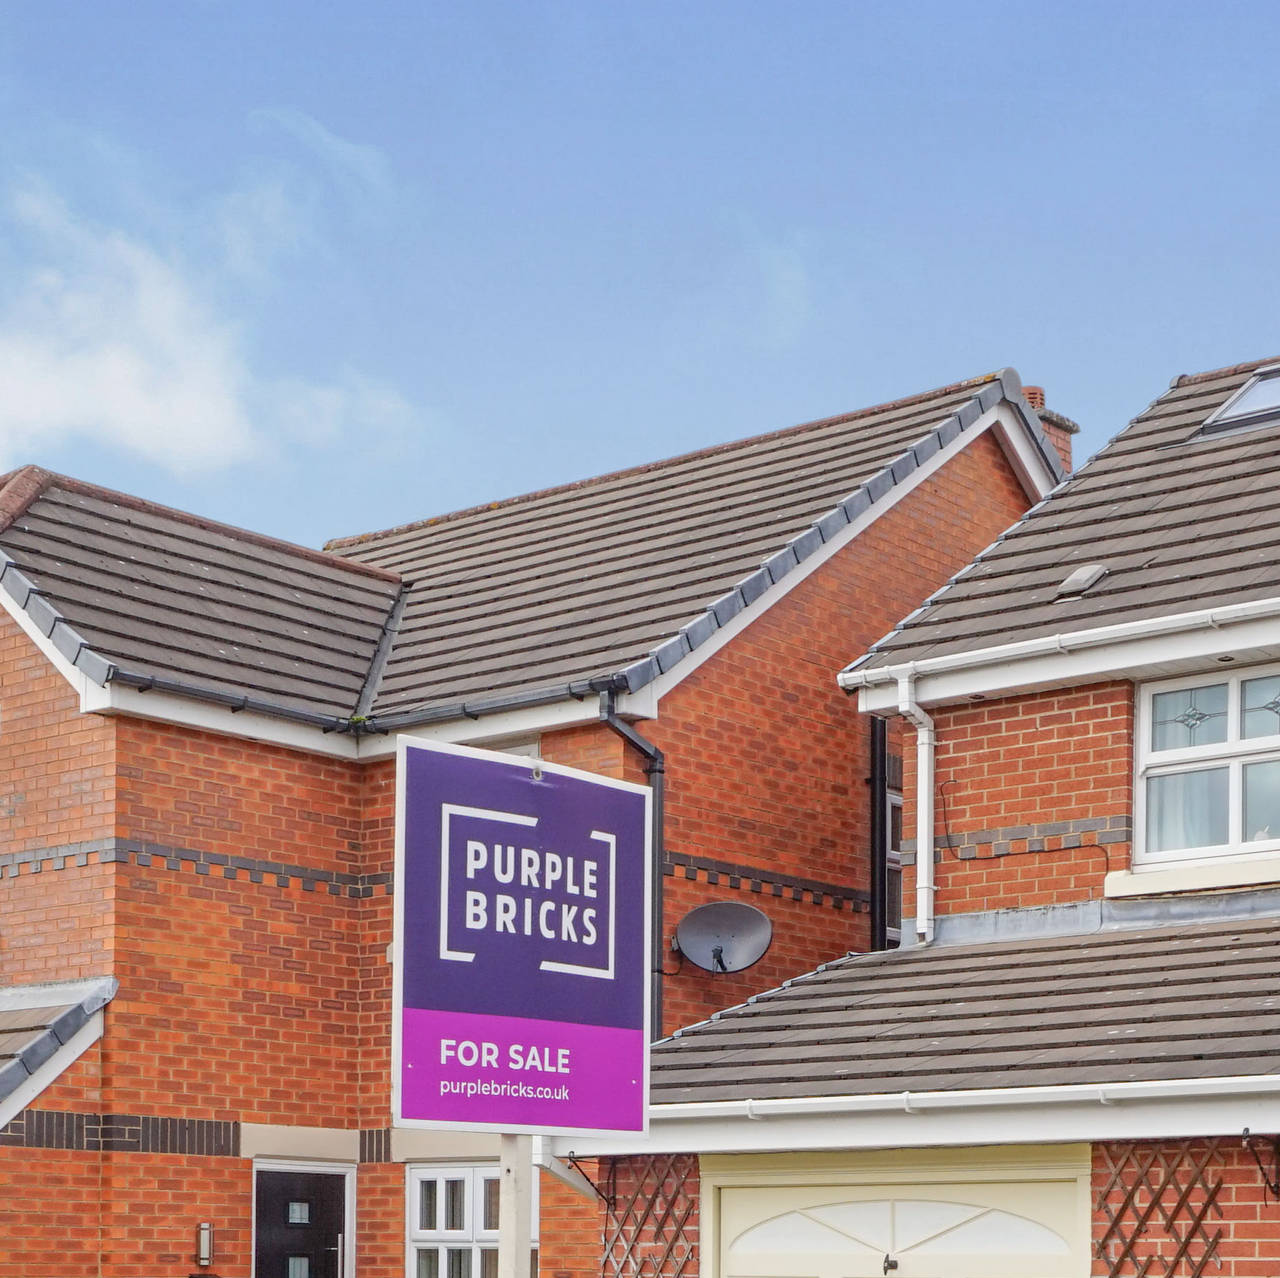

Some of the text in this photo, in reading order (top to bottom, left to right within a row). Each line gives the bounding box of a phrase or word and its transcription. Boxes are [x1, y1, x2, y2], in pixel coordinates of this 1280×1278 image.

[466, 840, 598, 898] PURPLE
[465, 890, 598, 946] BRICKS
[440, 1038, 570, 1074] FOR SALE
[440, 1078, 569, 1100] purplebricks.co.uk
